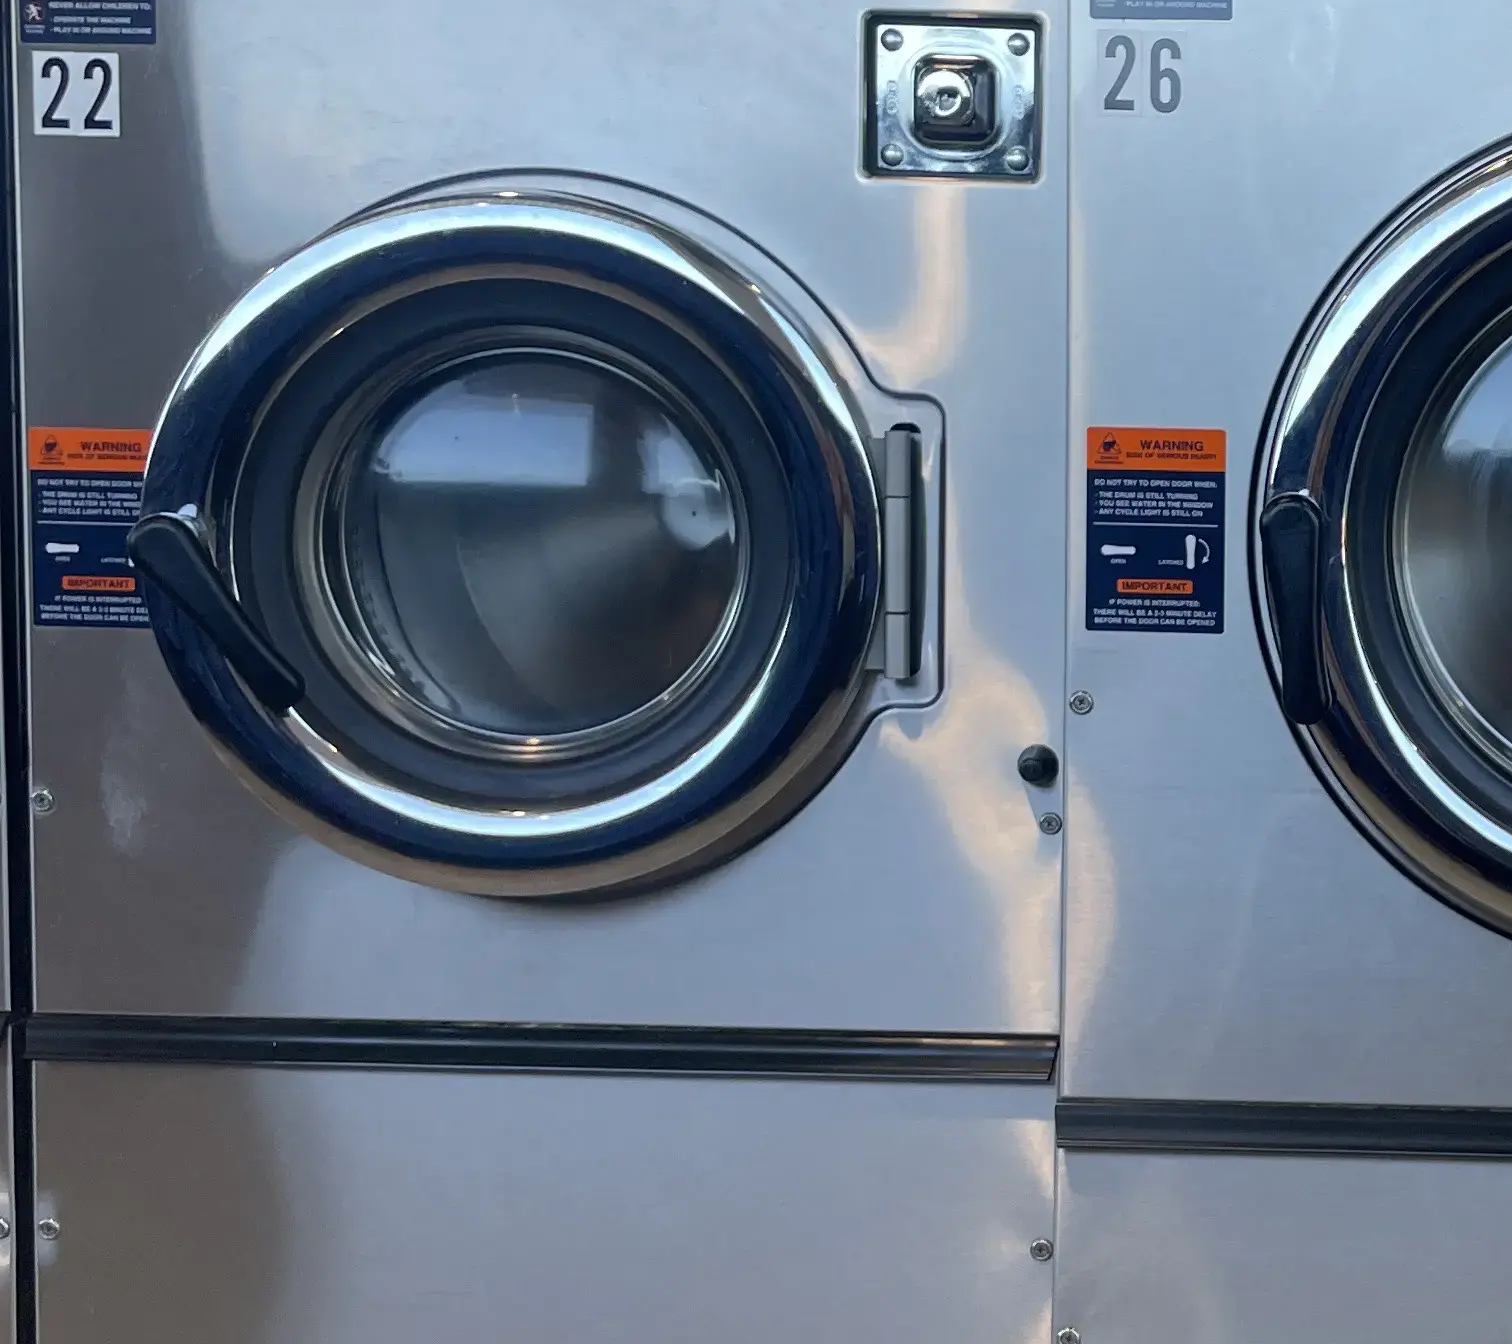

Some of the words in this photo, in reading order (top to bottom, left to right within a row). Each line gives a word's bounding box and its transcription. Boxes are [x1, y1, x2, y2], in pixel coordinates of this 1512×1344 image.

[42, 57, 112, 129] 22
[1104, 35, 1181, 113] 26
[1140, 440, 1204, 451] WARNING
